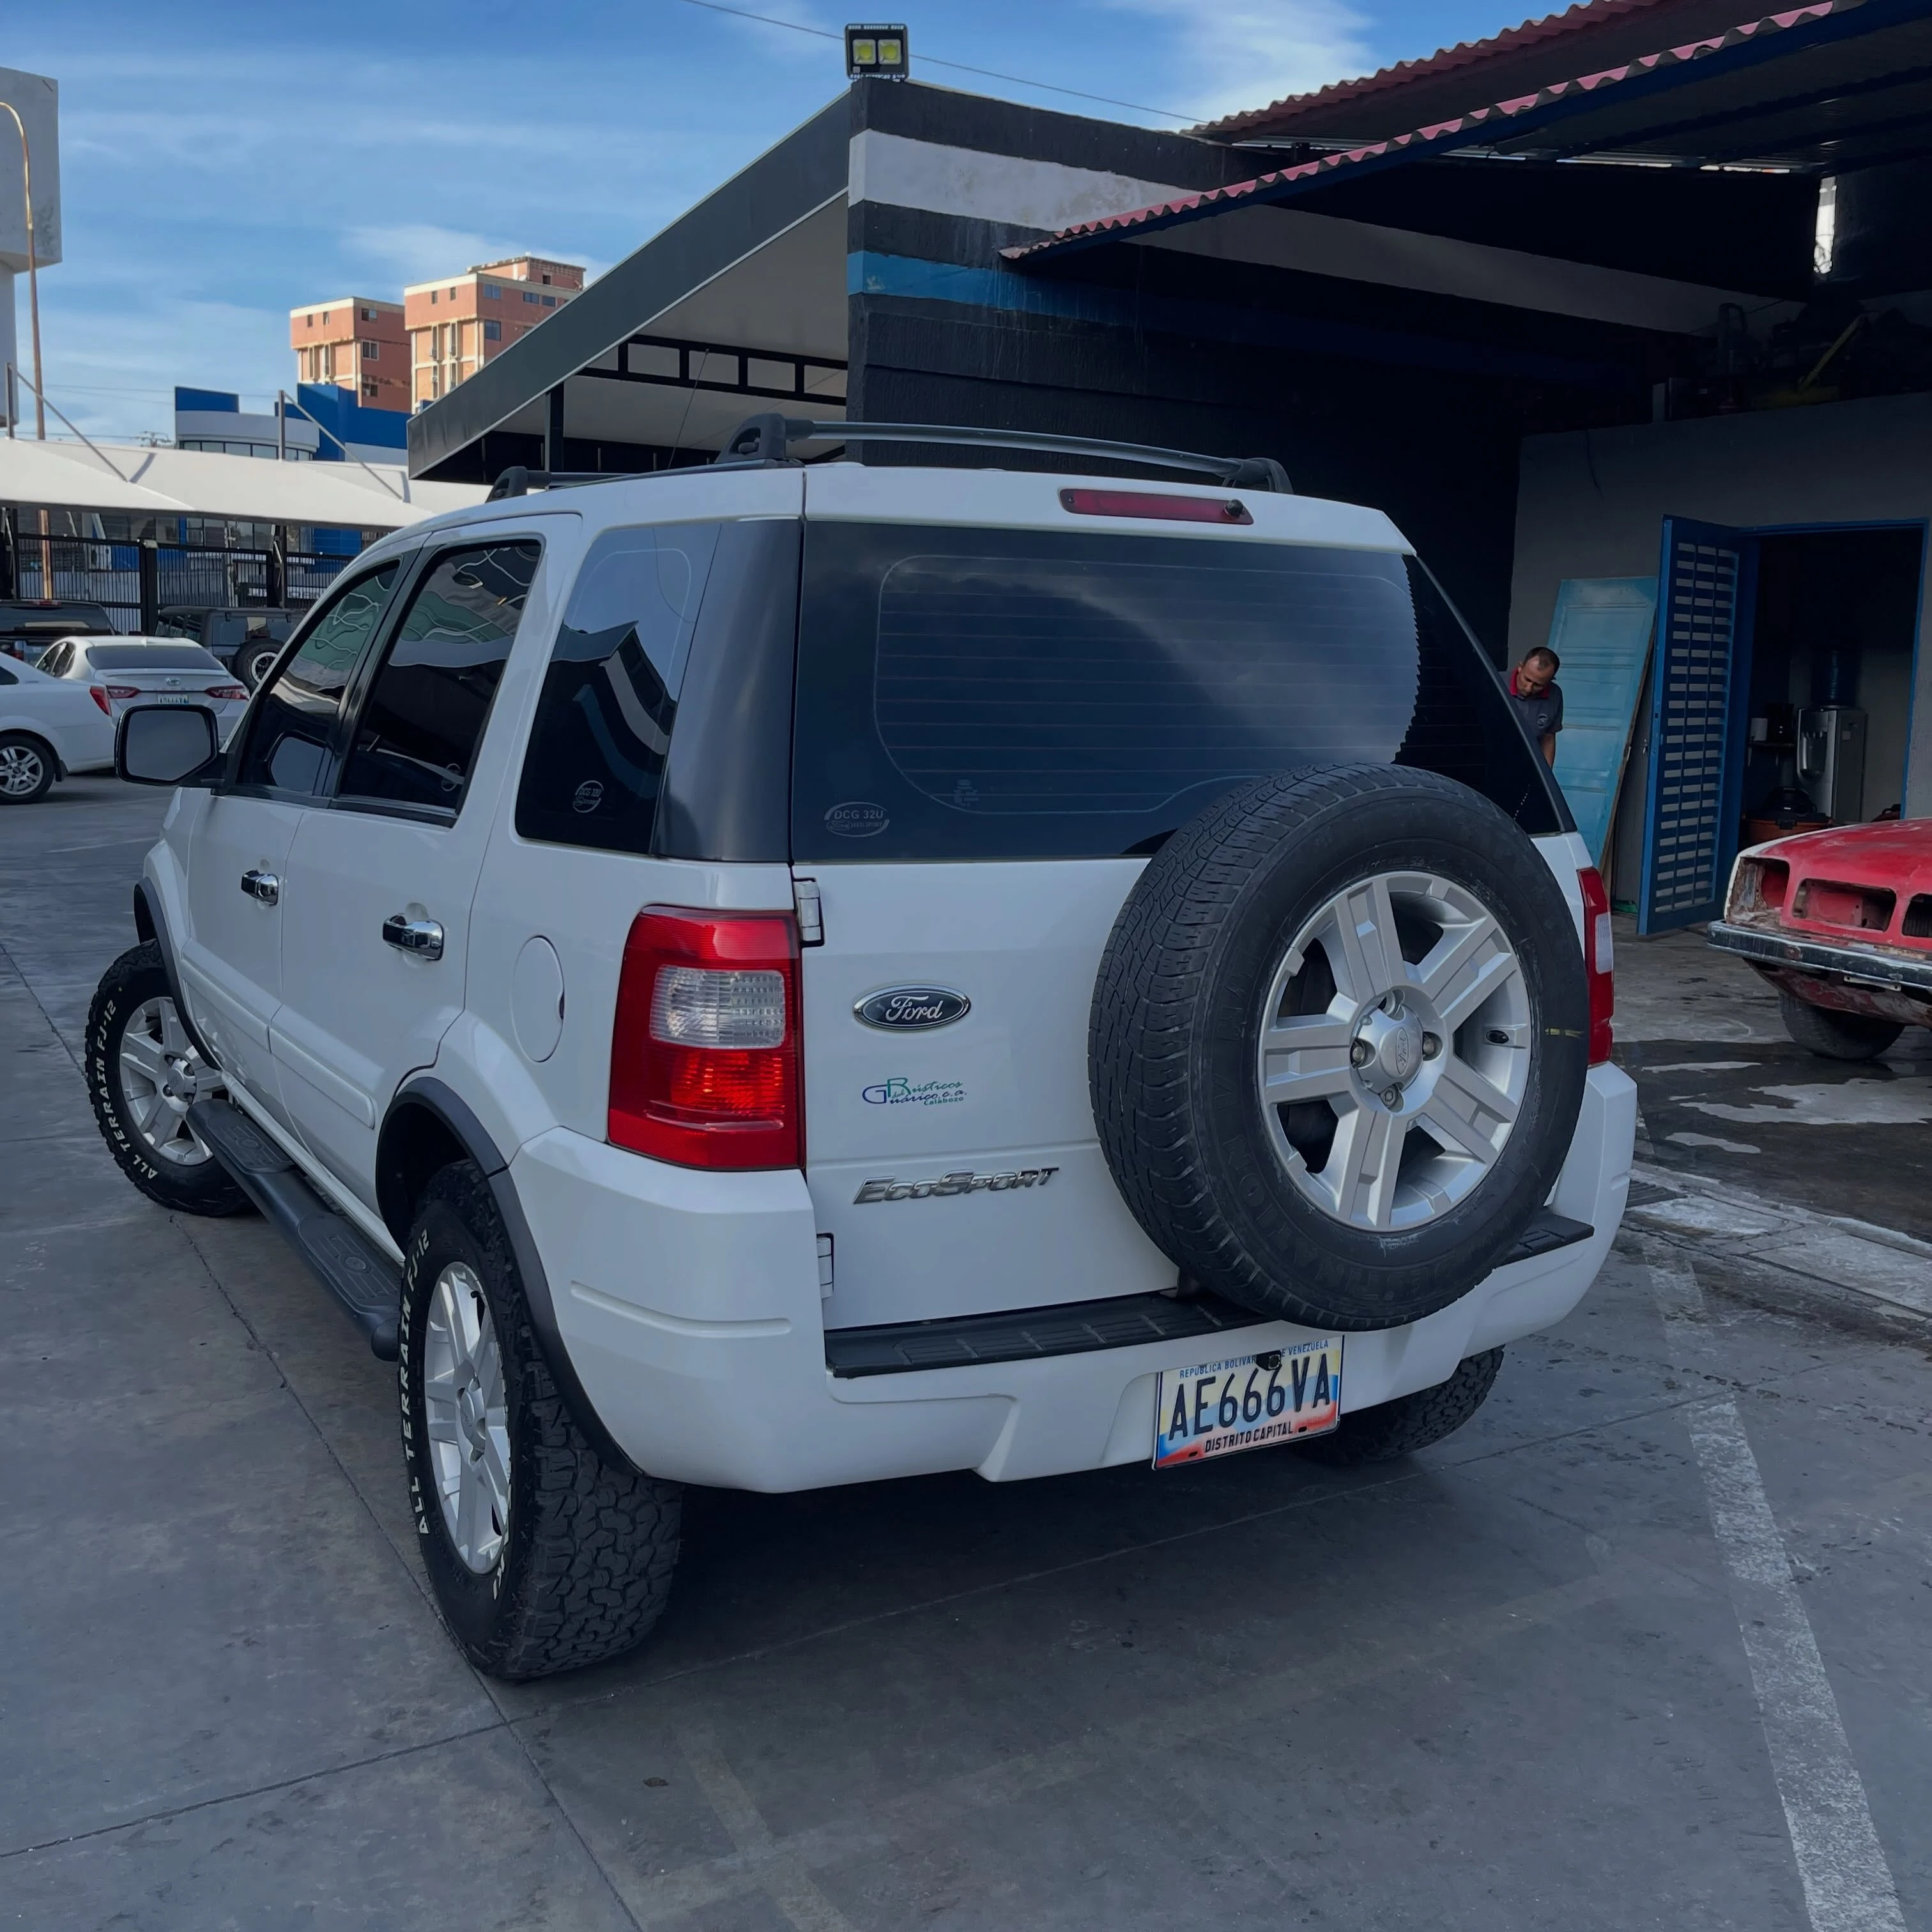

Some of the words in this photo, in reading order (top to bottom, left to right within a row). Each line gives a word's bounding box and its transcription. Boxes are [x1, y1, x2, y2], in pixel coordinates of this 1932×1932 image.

[834, 809, 859, 820] DCG
[863, 809, 884, 819] 32U
[885, 995, 944, 1021] Ford
[96, 1057, 132, 1153] TERRAIN
[125, 1153, 158, 1179] ALL
[1224, 1354, 1257, 1370] BOLIVAR
[1288, 1339, 1328, 1355] VENEZUELA
[400, 1294, 415, 1461] TERRAIN
[1169, 1353, 1330, 1441] AE666VA
[1205, 1431, 1252, 1453] DISTRITO
[1254, 1421, 1293, 1442] CAPITAL
[411, 1476, 429, 1534] ALL
